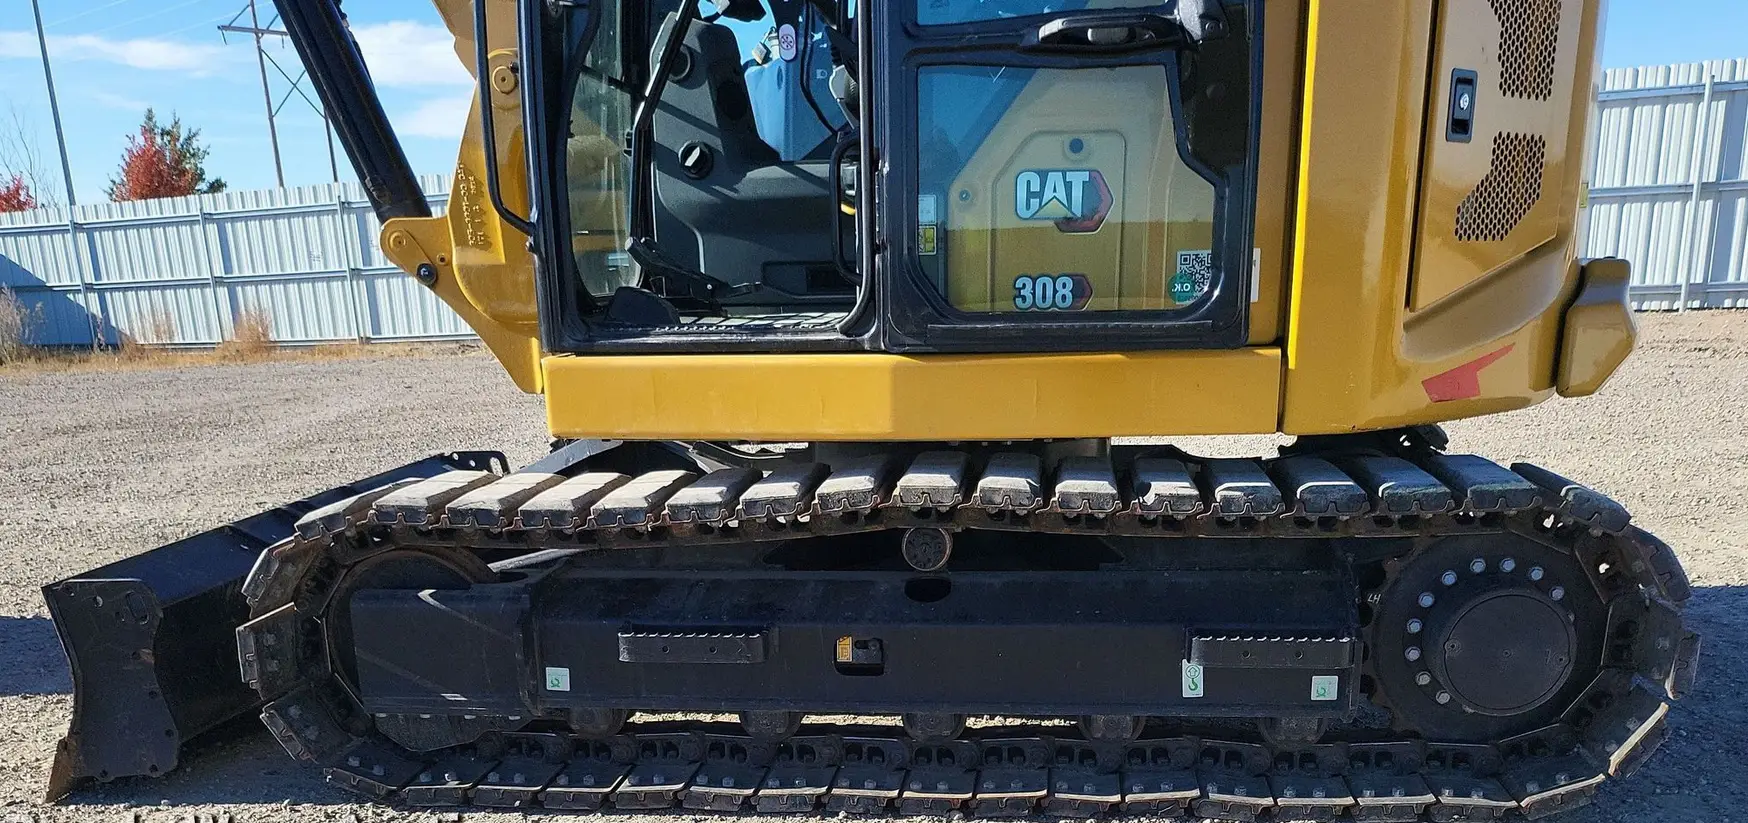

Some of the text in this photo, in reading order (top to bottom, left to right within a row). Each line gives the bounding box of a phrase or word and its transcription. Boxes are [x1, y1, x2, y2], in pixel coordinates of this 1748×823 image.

[1016, 171, 1090, 218] CAT
[1015, 276, 1074, 309] 308
[1367, 593, 1381, 605] LH
